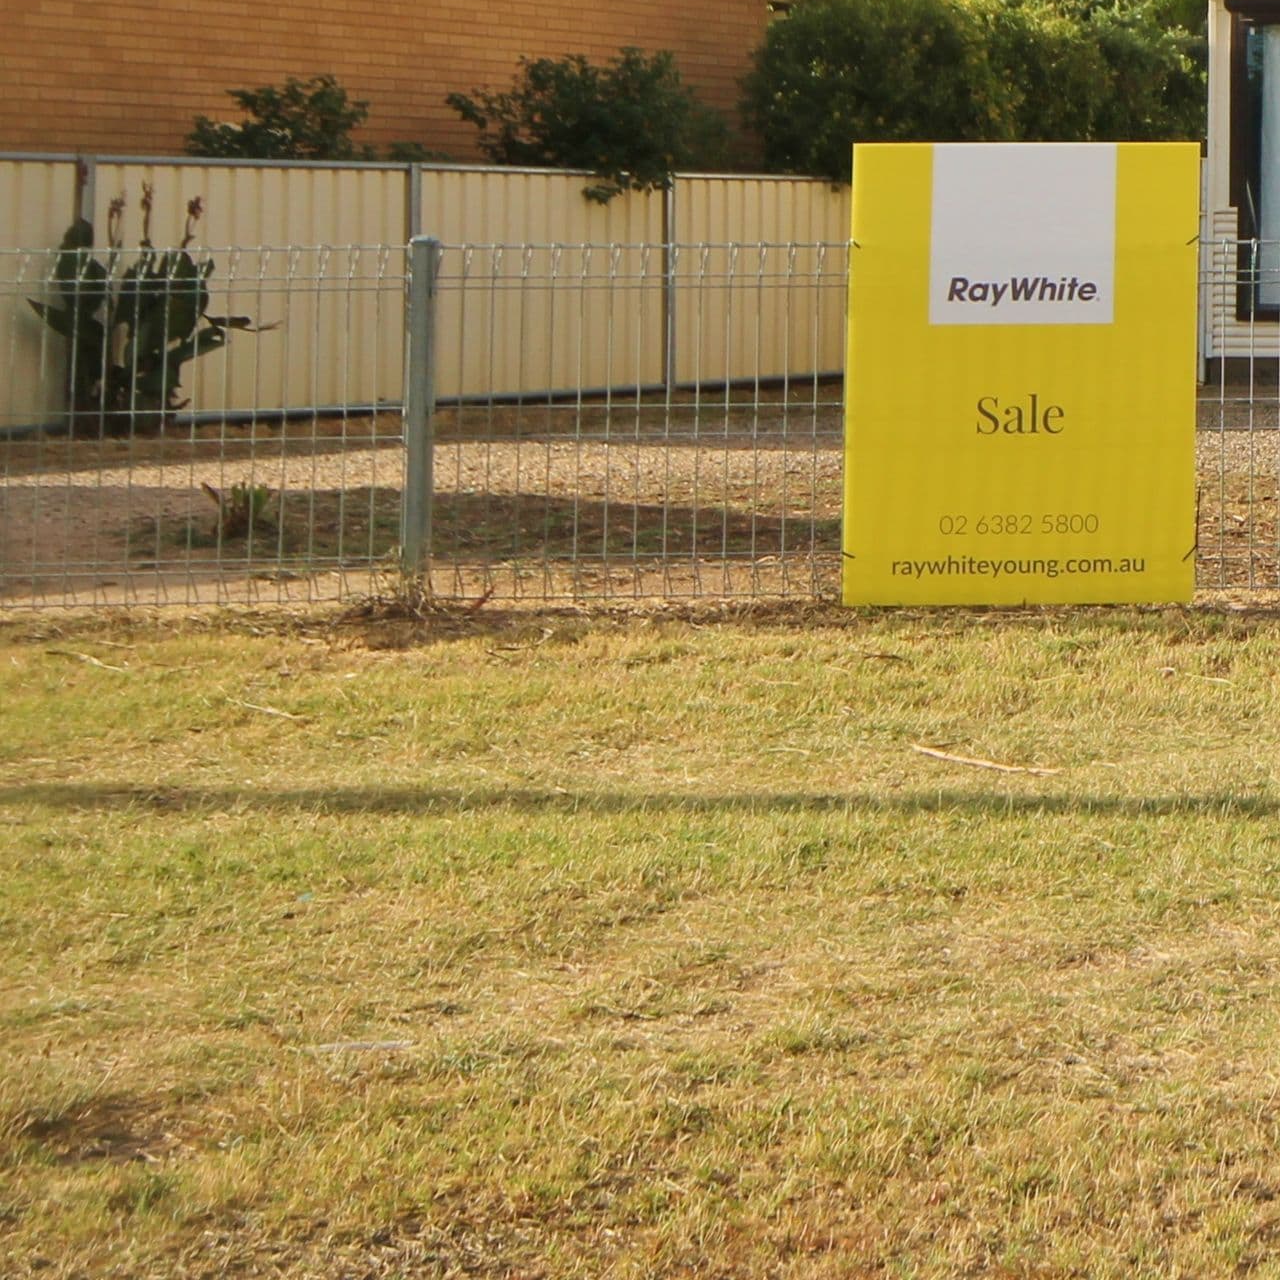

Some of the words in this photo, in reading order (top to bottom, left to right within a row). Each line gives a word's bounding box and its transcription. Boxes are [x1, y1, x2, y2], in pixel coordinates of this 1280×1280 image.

[976, 393, 1065, 435] Sale
[939, 515, 968, 535] 02
[975, 515, 1033, 535] 6382
[1041, 514, 1099, 535] 5800
[891, 554, 1145, 578] raywhiteyoung.com.au
